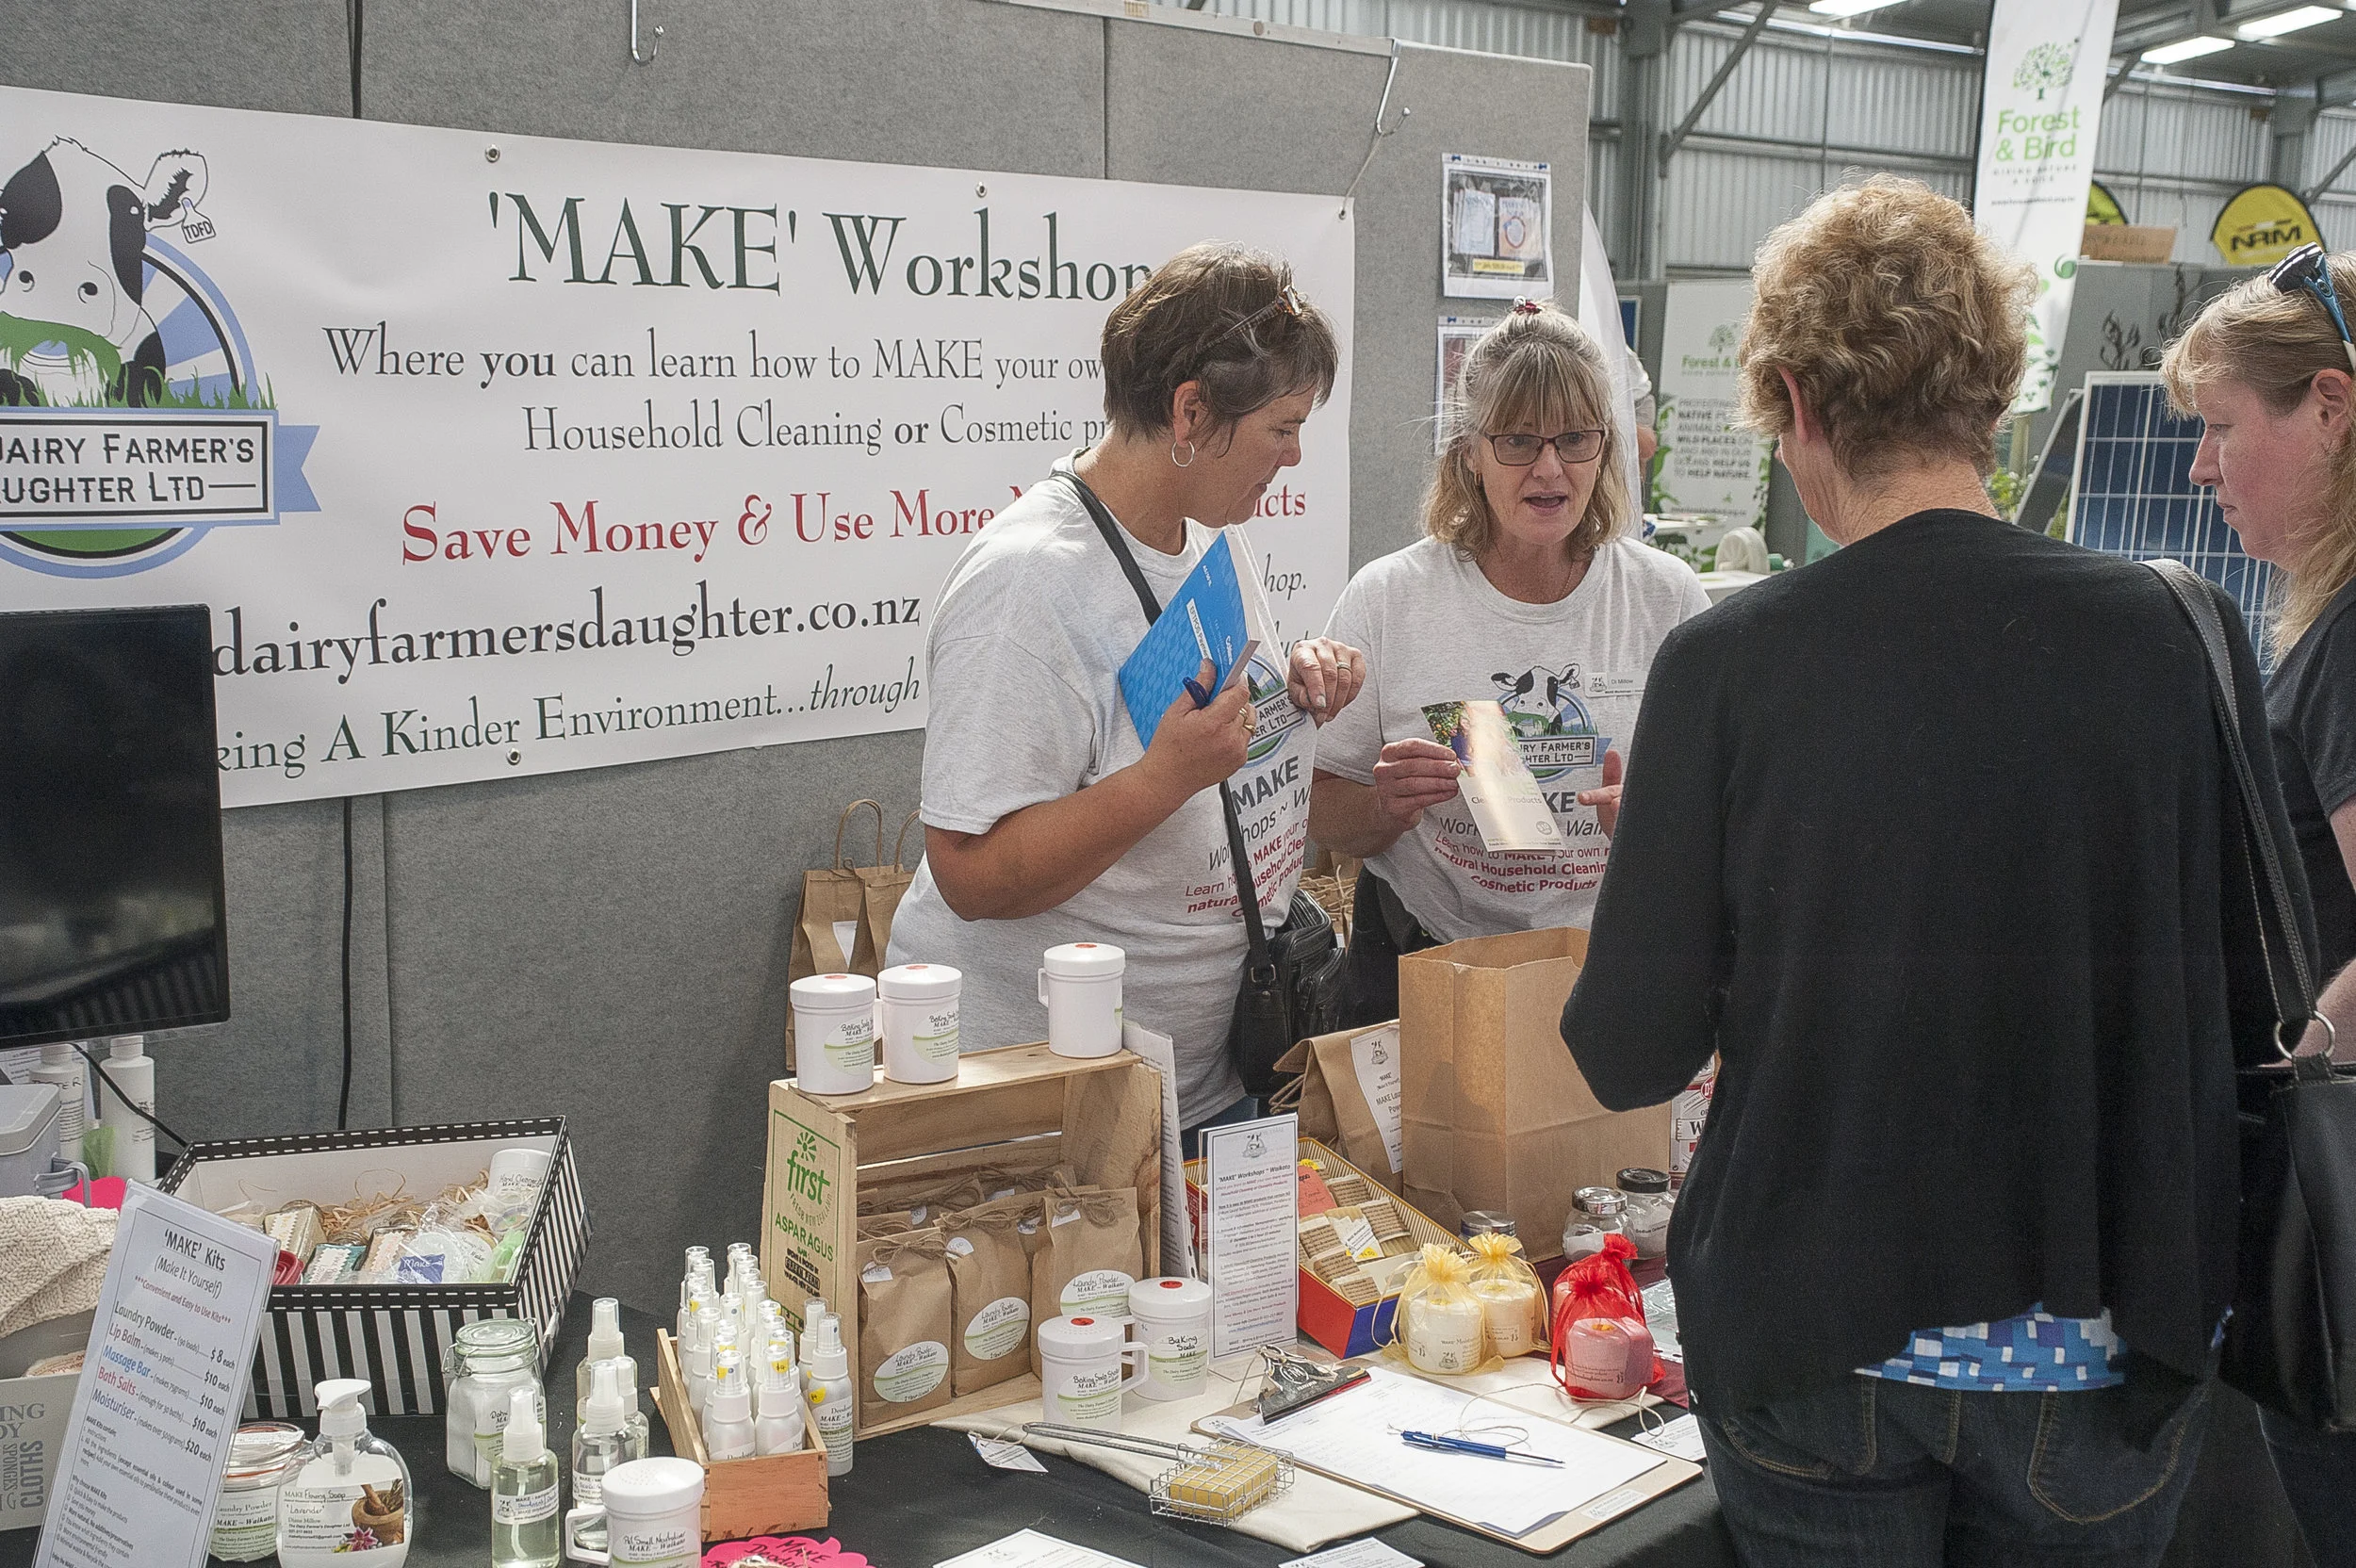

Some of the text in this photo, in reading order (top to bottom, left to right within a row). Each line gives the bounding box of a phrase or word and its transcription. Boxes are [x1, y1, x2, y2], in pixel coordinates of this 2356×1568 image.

[1998, 106, 2080, 134] Forest
[1996, 133, 2076, 161] & Bird
[184, 222, 213, 242] TDFD
[488, 191, 796, 298] 'MAKE'
[2231, 225, 2301, 252] NRM
[323, 322, 463, 376] Where
[479, 346, 555, 388] you
[571, 350, 636, 377] can
[647, 328, 735, 379] learn
[751, 331, 816, 380] how
[828, 346, 859, 379] to
[874, 338, 983, 380] MAKE
[995, 354, 1058, 388] your
[523, 400, 723, 450] Household
[736, 400, 882, 456] Cleaning
[893, 424, 928, 444] or
[941, 403, 1072, 444] Cosmetic
[0, 433, 254, 464] AIRY FARMER'S
[0, 471, 204, 503] UGHTER LTD
[401, 500, 531, 565] Save
[549, 499, 719, 564] Money
[738, 496, 772, 544] &
[791, 492, 874, 543] Use
[891, 488, 995, 540] More
[322, 713, 367, 762] A
[380, 694, 520, 758] Kinder
[1541, 741, 1591, 752] FARMER'S
[1554, 752, 1574, 763] LTD
[1231, 756, 1299, 815] MAKE
[1463, 842, 1484, 858] how
[1578, 847, 1599, 858] own
[1186, 882, 1224, 897] Learn
[1253, 836, 1283, 866] MAKE
[1481, 861, 1556, 877] Household
[1470, 874, 1598, 893] Cosmetic Products
[1376, 1093, 1394, 1105] MAKE
[786, 1149, 830, 1205] first
[164, 1228, 226, 1271] 'MAKE' Kits
[775, 1212, 834, 1263] ASPARAGUS
[155, 1254, 180, 1277] (Make
[188, 1268, 222, 1299] Yourself)
[171, 1293, 182, 1305] and
[182, 1295, 195, 1312] Easy
[194, 1302, 202, 1313] to
[201, 1305, 212, 1318] Use
[114, 1300, 143, 1329] Laundry
[144, 1315, 175, 1341] Powder
[222, 1358, 236, 1370] each
[1168, 1335, 1198, 1345] Baking
[1176, 1343, 1196, 1351] Soda
[108, 1322, 121, 1342] Lip
[122, 1328, 141, 1349] Balm
[204, 1369, 219, 1386] $10
[218, 1380, 231, 1393] each
[103, 1345, 137, 1373] Massage
[136, 1362, 152, 1380] Bar
[199, 1394, 214, 1410] $10
[213, 1405, 226, 1417] each
[1073, 1375, 1094, 1384] Baking
[98, 1365, 117, 1387] Bath
[118, 1376, 137, 1396] Salts
[191, 1415, 206, 1432] $10
[205, 1427, 218, 1440] each
[92, 1388, 136, 1422] Moisturiser
[185, 1437, 201, 1456] $20
[199, 1450, 213, 1463] each
[3, 1443, 19, 1492] SPONGES
[20, 1440, 44, 1508] CLOTHS
[245, 1500, 272, 1512] Powder
[285, 1490, 303, 1498] MAKE
[328, 1489, 346, 1501] Soap
[217, 1514, 275, 1527] MAKE Waikato
[629, 1544, 651, 1553] MAKE
[776, 1539, 831, 1564] MAKE
